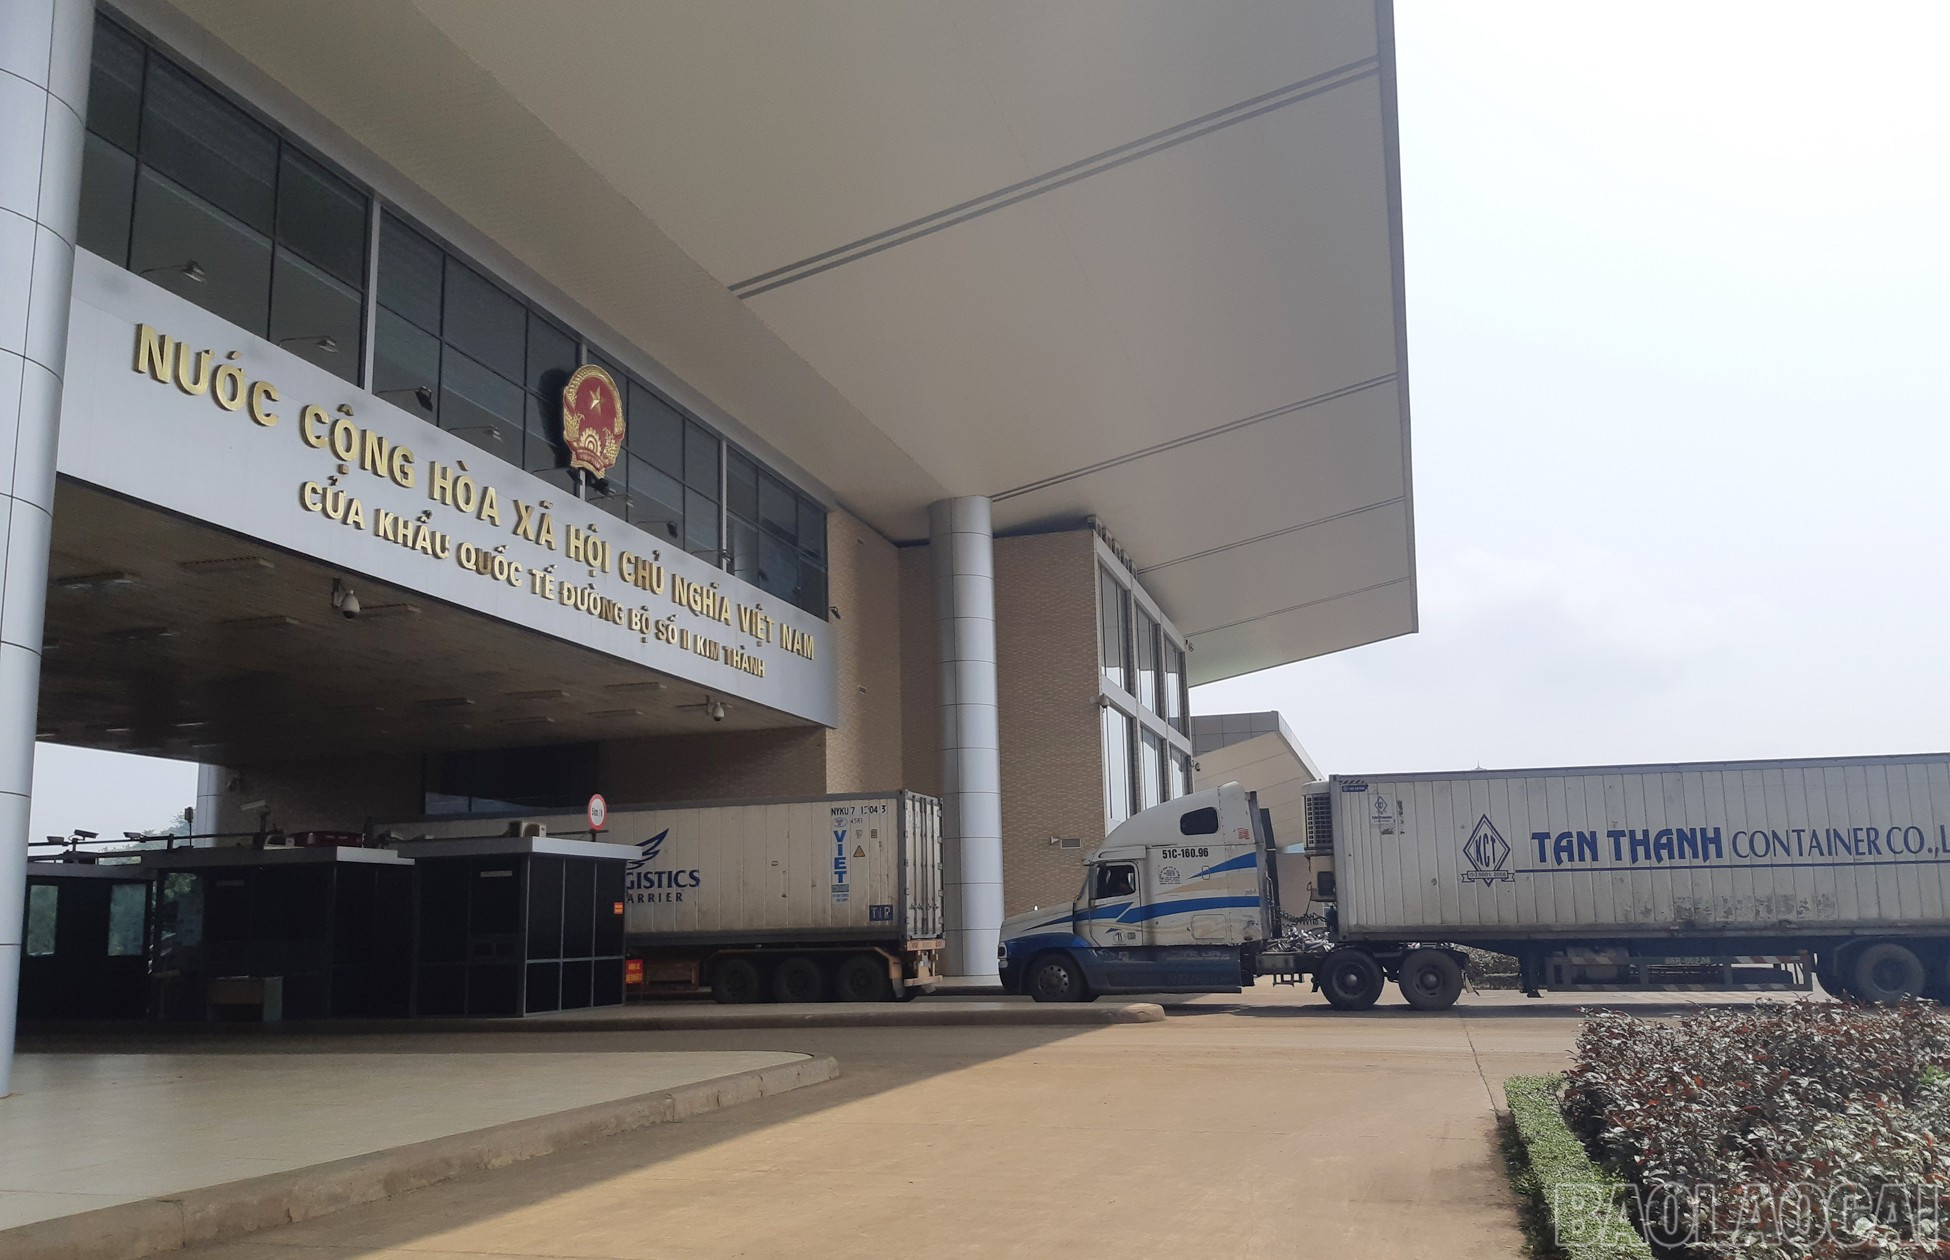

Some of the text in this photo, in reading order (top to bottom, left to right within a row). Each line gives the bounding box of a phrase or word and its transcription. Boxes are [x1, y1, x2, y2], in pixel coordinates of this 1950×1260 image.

[133, 323, 815, 660] NƯỚC CỘNG HÒA XÃ HỘI CHỦ NGHĨA VIỆT NAM
[301, 475, 366, 530] CỬA
[374, 509, 450, 559] KHẨU
[456, 542, 523, 587] QUỐC
[528, 564, 558, 600] TẾ
[559, 581, 625, 626] ĐƯỜNG
[628, 605, 652, 643] BỘ
[655, 614, 679, 645] SỐ
[693, 634, 719, 661] KIM
[722, 645, 766, 678] THÀNH
[832, 829, 848, 884] VIET
[1162, 847, 1209, 859] 51C-160.96
[1475, 833, 1496, 868] KCT
[1531, 830, 1599, 866] TAN
[1606, 827, 1724, 865] THANH
[1732, 827, 1882, 858] CONTAINER
[870, 906, 891, 920] TIR
